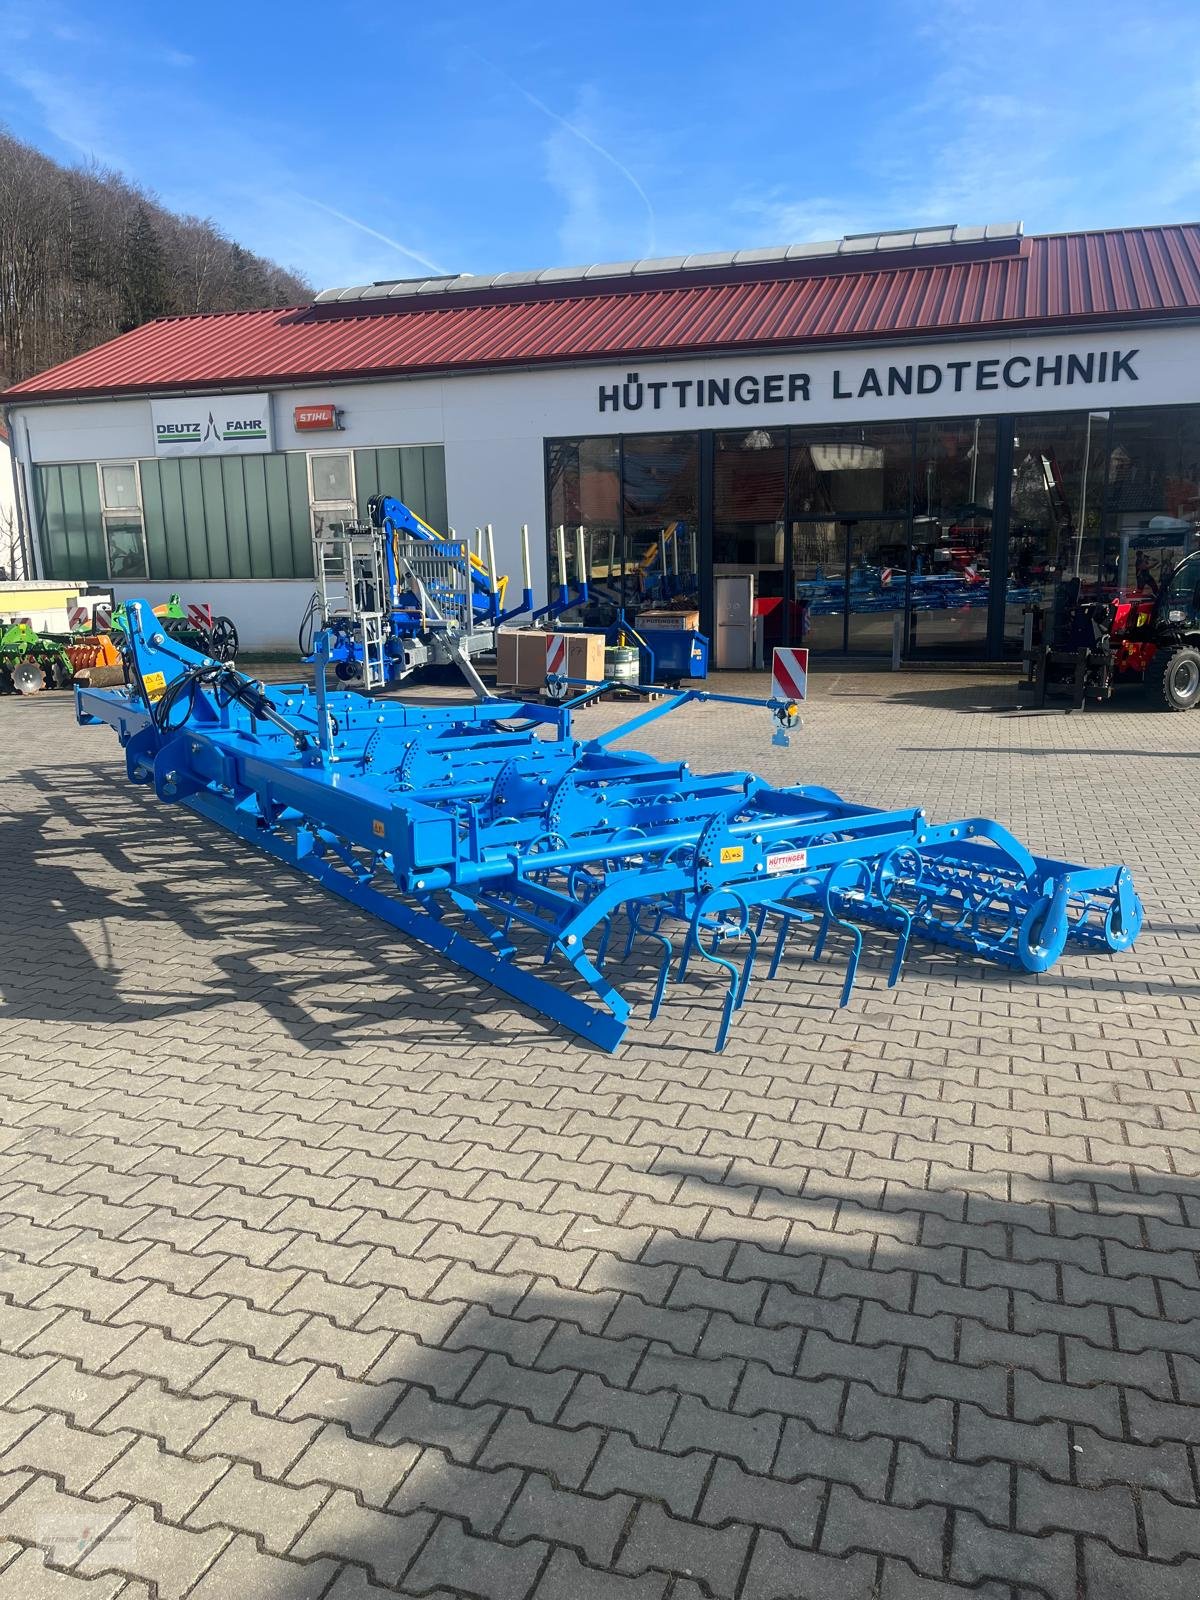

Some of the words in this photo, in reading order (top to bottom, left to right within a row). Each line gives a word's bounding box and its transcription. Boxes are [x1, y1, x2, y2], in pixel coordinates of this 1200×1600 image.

[599, 372, 810, 412] HÜTTINGER
[832, 349, 1140, 400] LANDTECHNIK
[299, 412, 329, 422] STIHL
[156, 423, 201, 434] DEUTZ
[226, 420, 262, 431] FAHR
[768, 854, 804, 866] HÜTTINGER
